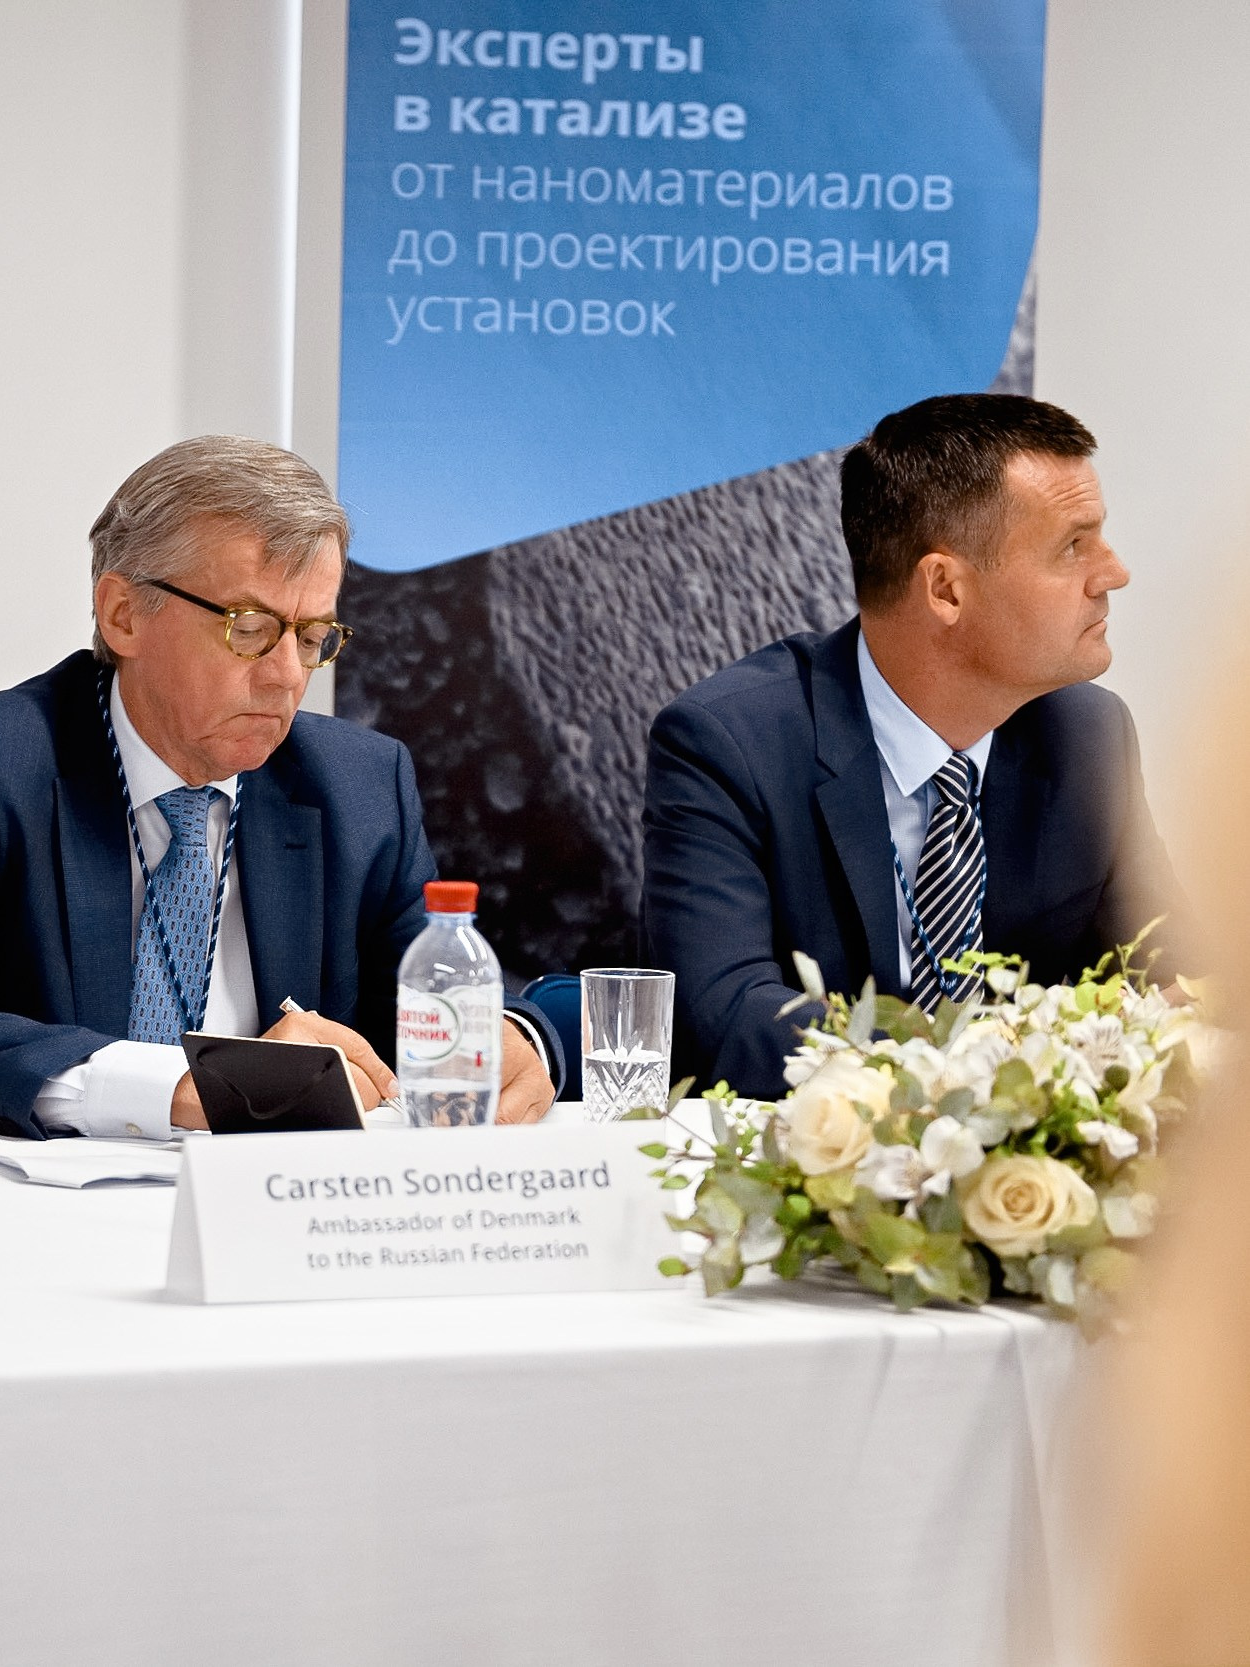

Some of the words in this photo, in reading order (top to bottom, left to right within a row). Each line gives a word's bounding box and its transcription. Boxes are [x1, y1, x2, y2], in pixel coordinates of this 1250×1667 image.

[394, 17, 704, 84] Эксперты
[394, 96, 431, 132] в
[450, 97, 747, 141] катализе
[391, 161, 454, 200] от
[472, 165, 954, 220] наноматериалов
[387, 229, 457, 275] до
[477, 230, 950, 285] проектирования
[385, 295, 676, 346] установок
[265, 1171, 393, 1203] Carsten
[402, 1160, 612, 1201] Sondergaard
[307, 1212, 445, 1237] Ambassador
[452, 1209, 474, 1231] of
[480, 1206, 581, 1230] Denmark
[306, 1251, 331, 1270] to
[336, 1248, 374, 1269] the
[380, 1244, 465, 1266] Russian
[471, 1239, 590, 1263] Federation
